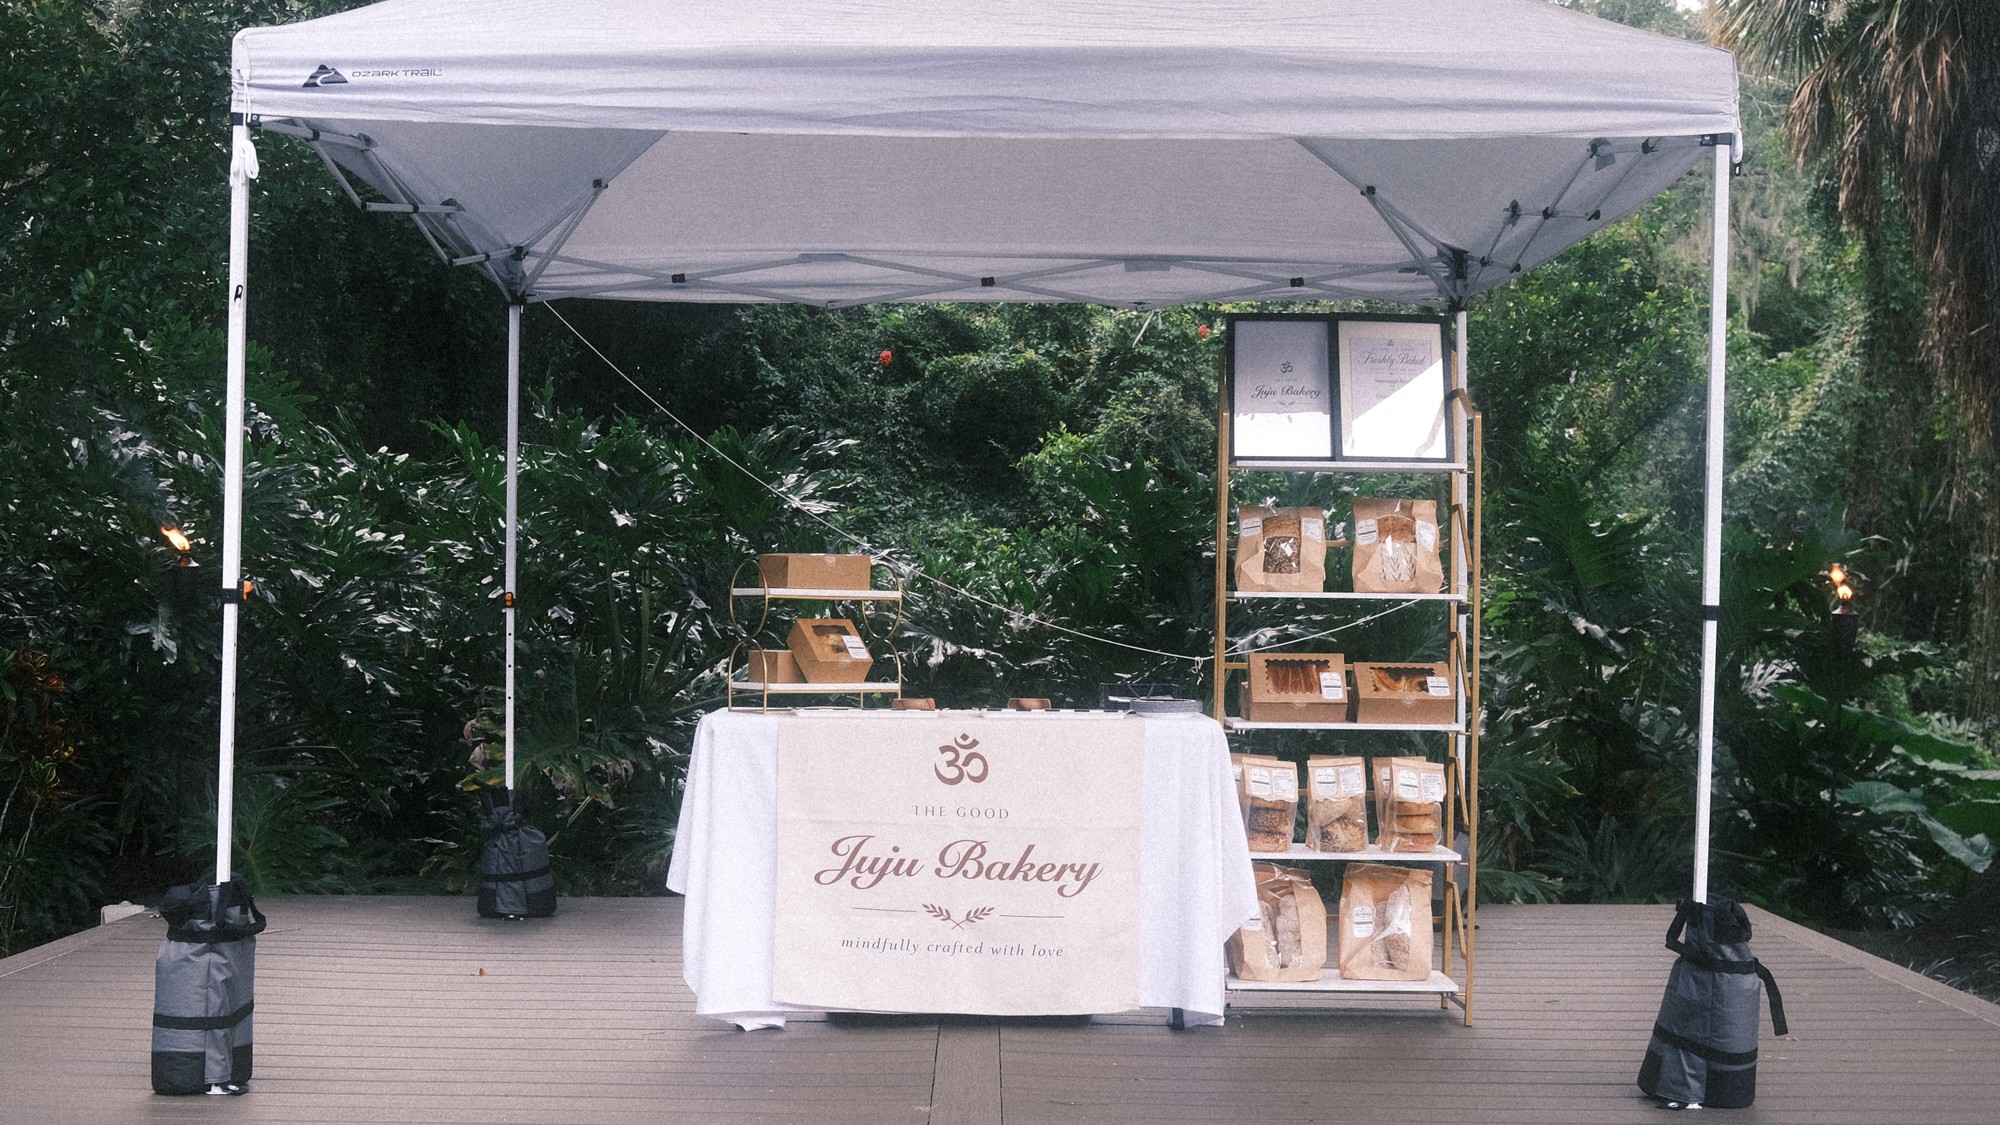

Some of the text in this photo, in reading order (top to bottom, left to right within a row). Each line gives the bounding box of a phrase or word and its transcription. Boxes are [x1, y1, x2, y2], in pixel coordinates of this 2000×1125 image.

[1358, 351, 1426, 367] Freshly Baked
[1251, 385, 1321, 399] Juju Bakery
[912, 805, 1010, 819] THE GOOD
[814, 834, 1104, 898] Juju Bakery
[841, 937, 1064, 958] mindfully crafted with love
